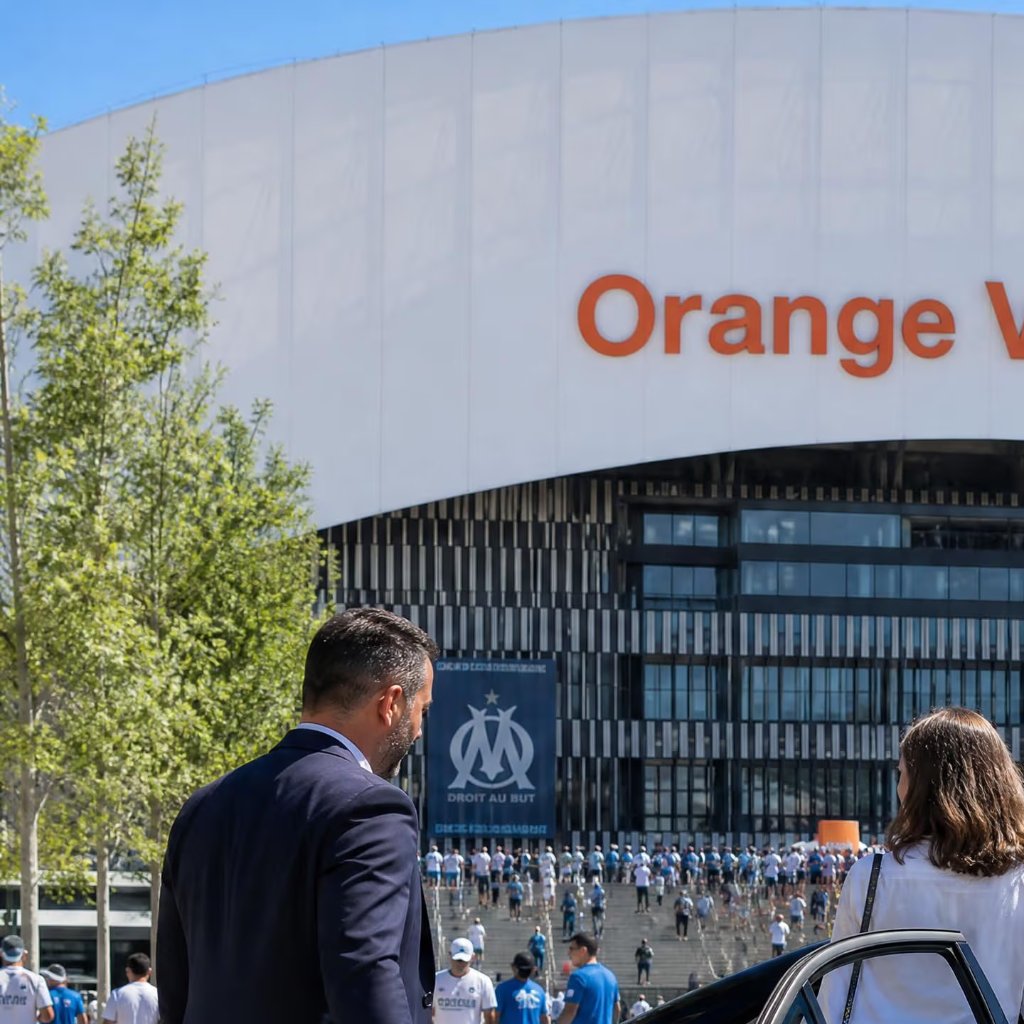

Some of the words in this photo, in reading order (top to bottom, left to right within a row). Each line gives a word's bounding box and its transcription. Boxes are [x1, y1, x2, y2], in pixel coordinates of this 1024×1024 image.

[577, 274, 956, 379] Orange
[447, 793, 485, 803] DROIT
[488, 793, 507, 803] AU
[510, 793, 537, 803] BUT
